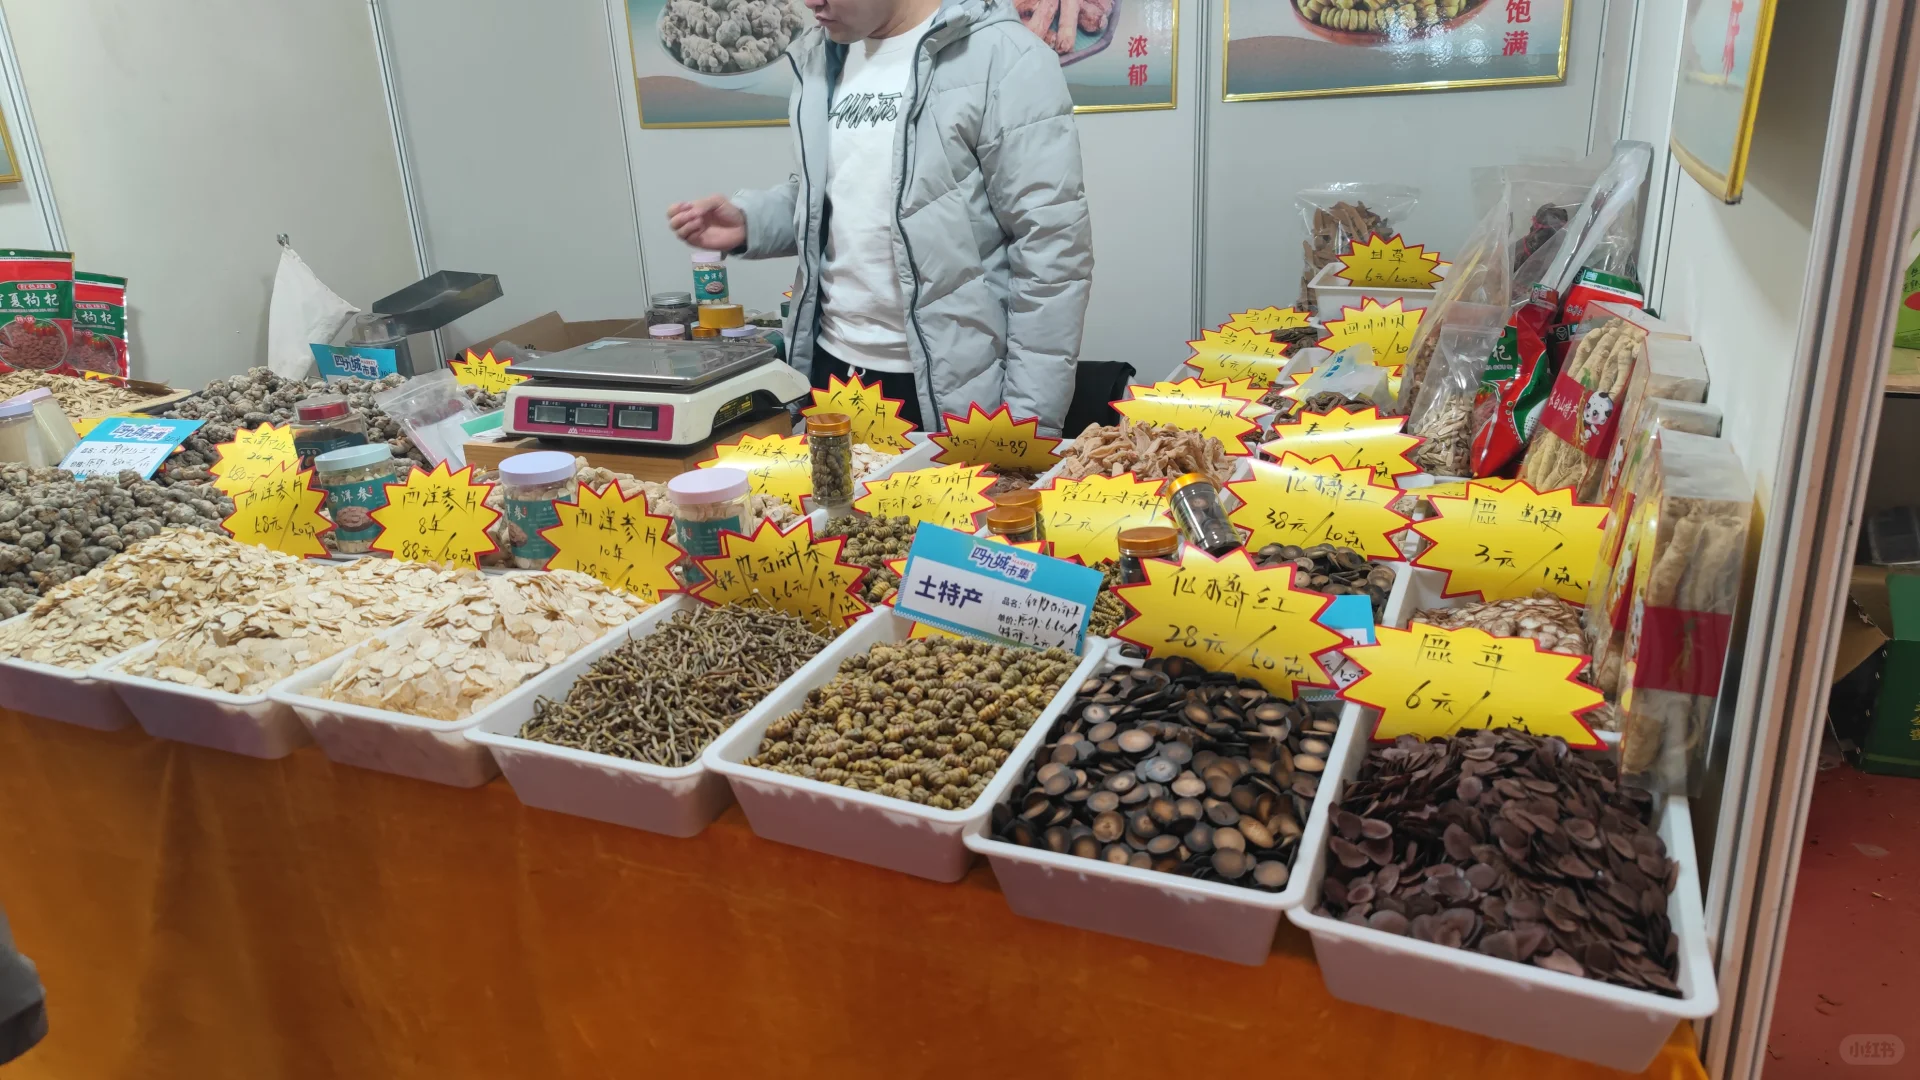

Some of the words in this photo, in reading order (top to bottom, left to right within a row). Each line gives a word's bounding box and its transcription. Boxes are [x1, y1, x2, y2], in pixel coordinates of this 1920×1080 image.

[1502, 0, 1531, 56] 饱满
[1127, 35, 1148, 86] 浓郁
[333, 355, 378, 377] 四九城市集
[329, 486, 373, 503] 西洋参
[402, 484, 477, 516] 西洋参片
[575, 507, 657, 556] 西洋参片
[970, 547, 1031, 580] 四九城市集
[1012, 558, 1034, 569] MARKET
[915, 575, 983, 609] 土特产
